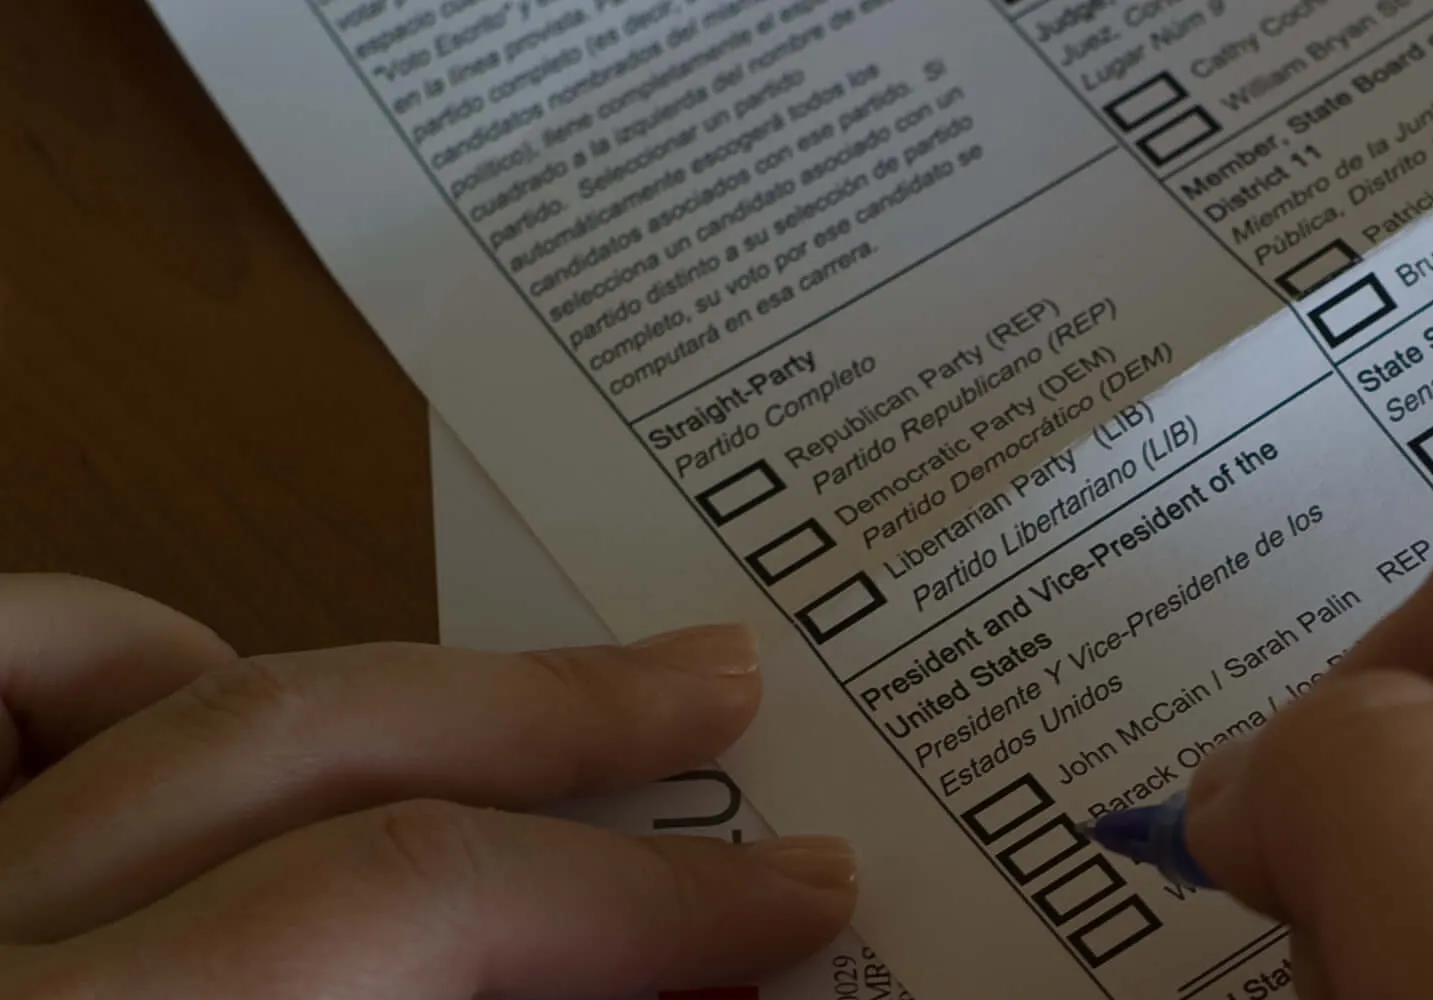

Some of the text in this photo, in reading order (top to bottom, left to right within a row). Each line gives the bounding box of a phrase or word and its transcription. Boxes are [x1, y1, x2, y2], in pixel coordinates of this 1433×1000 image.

[609, 242, 878, 396] computará en esa carrera.
[648, 350, 816, 450] Straight-Party
[784, 298, 1060, 469] Republican Party (REP)
[812, 297, 1117, 496] Partido Republicano (REP)
[1357, 345, 1424, 393] State
[675, 356, 876, 480] Partido Completo
[833, 346, 1117, 526] Democratic Party (DEM)
[862, 341, 1173, 550] Partido Democrático (DEM)
[882, 399, 1155, 580] Libertarian Party (LIB)
[859, 442, 1279, 712] President and Vice-President of the
[912, 415, 1198, 613] Partido Libertariano (LIB)
[884, 632, 1053, 739] United States
[914, 504, 1324, 769] Presidente Y Vice-Presidente de los
[1058, 539, 1430, 785] John McCain / Sarah Palin REP
[939, 675, 1123, 797] Estados Unidos
[1088, 765, 1179, 820] Barack
